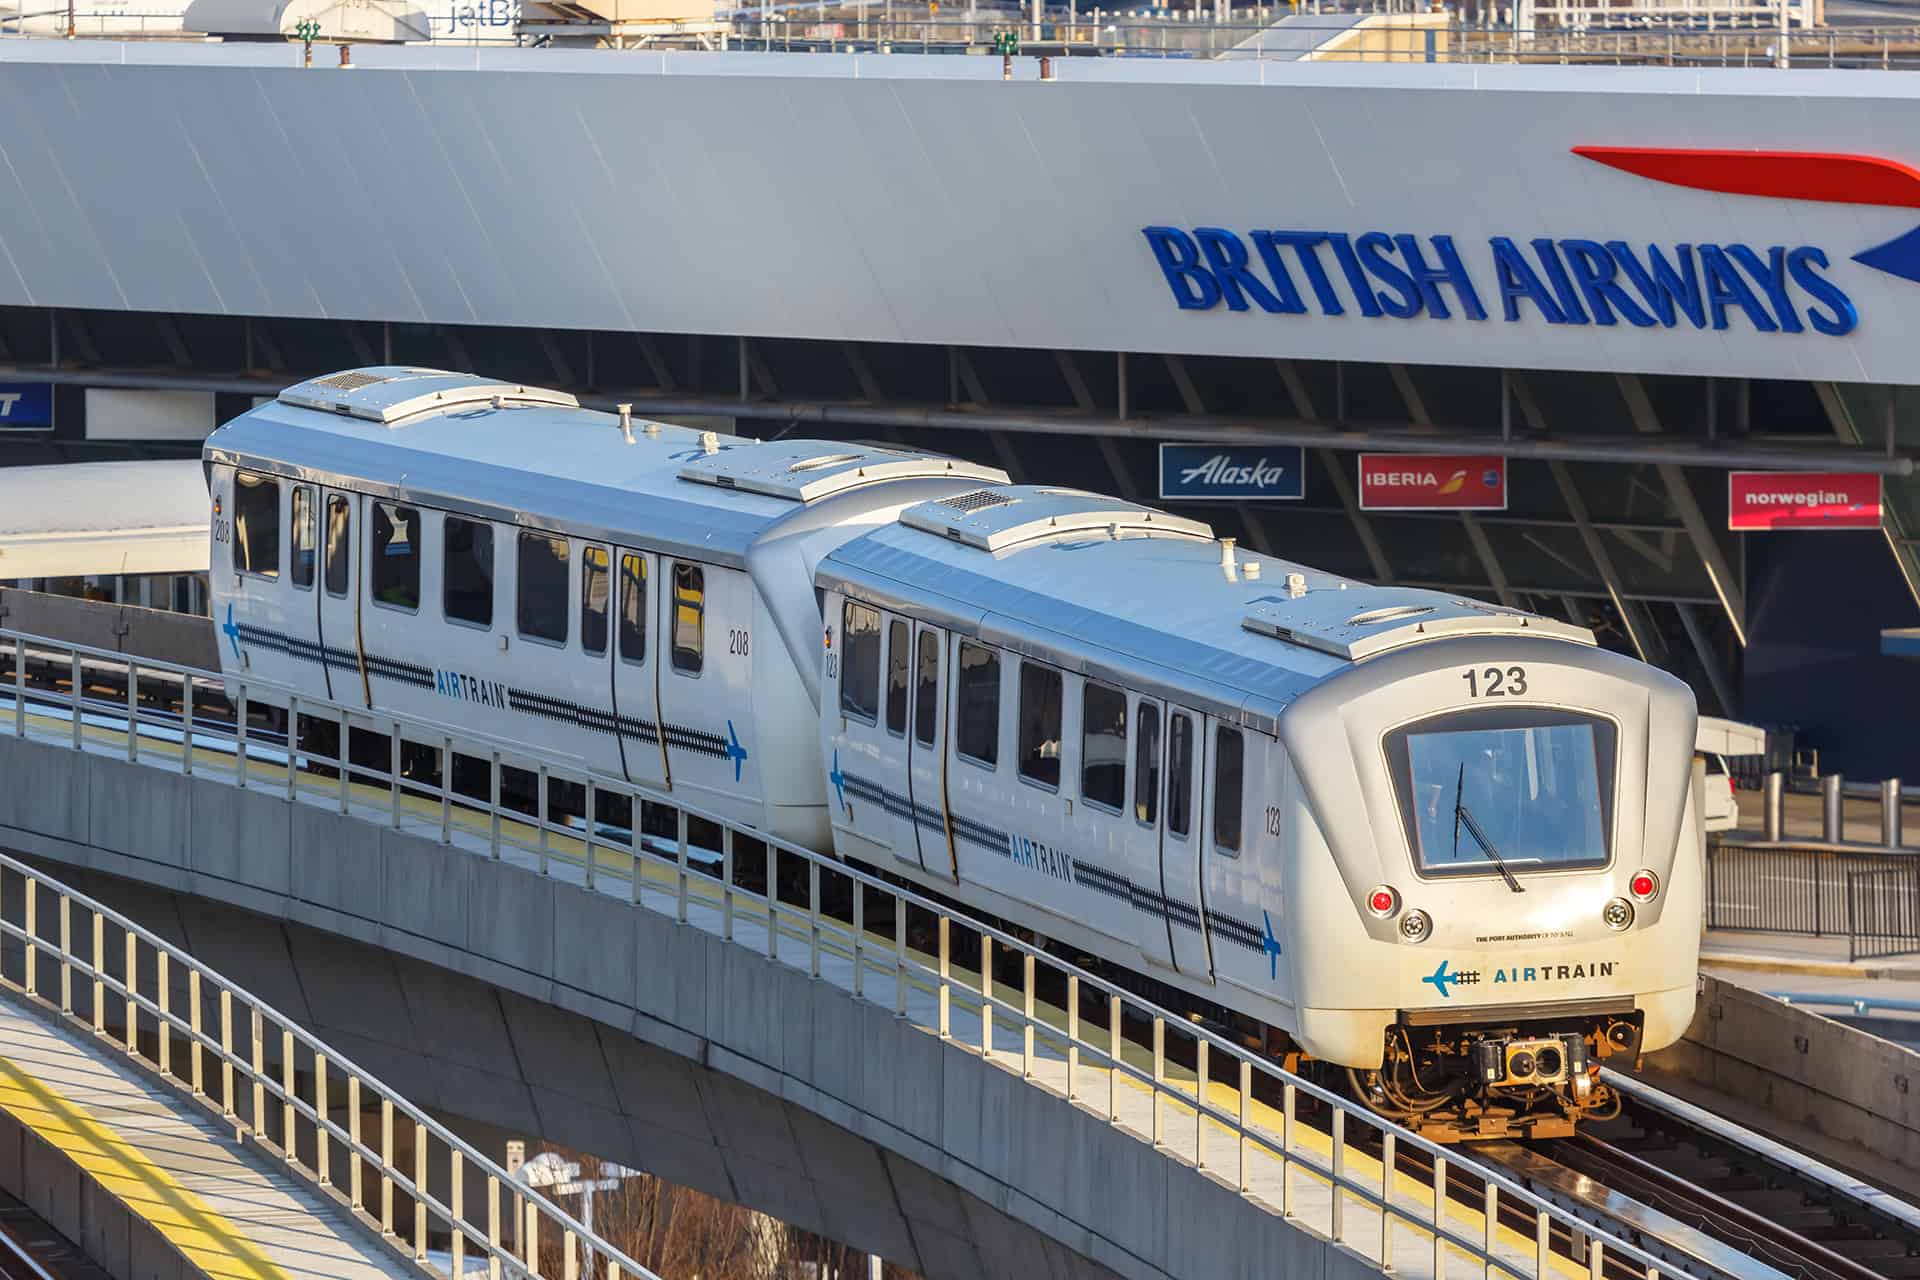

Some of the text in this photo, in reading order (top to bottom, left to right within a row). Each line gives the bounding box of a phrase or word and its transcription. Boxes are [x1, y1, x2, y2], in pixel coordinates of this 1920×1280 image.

[1142, 226, 1858, 337] BRITISH AIRWAYS
[1181, 455, 1283, 488] Alaska
[1366, 472, 1437, 487] IBERIA
[1745, 490, 1849, 507] norwegian
[215, 519, 230, 544] 208
[729, 629, 749, 656] 208
[825, 652, 838, 679] 123
[437, 669, 505, 710] AIRTRAIN
[1462, 666, 1528, 697] 123
[1266, 806, 1280, 837] 123
